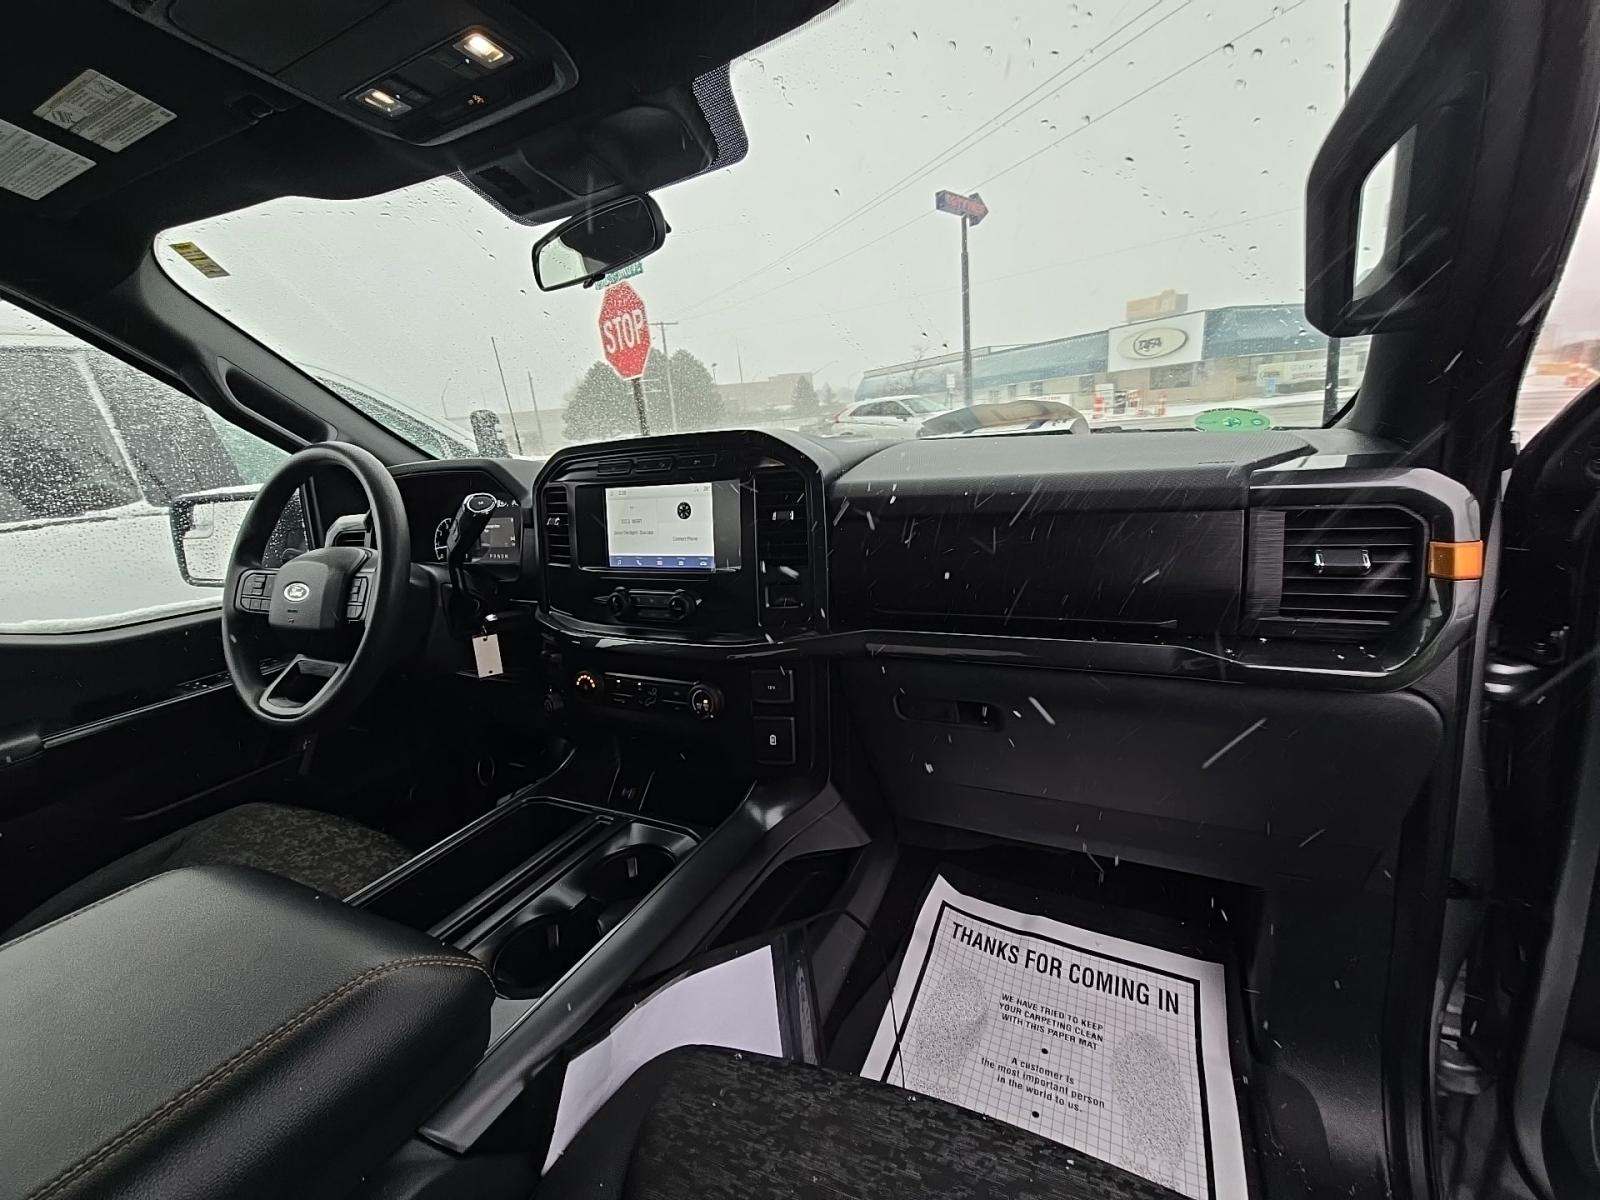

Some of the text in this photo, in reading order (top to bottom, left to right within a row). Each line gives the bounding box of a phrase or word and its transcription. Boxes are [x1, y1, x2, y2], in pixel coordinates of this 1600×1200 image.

[603, 308, 643, 354] STOP
[952, 922, 1179, 1015] THANKS FOR COMING IN
[1000, 1002, 1104, 1042] YOUR CARPETING CLEAN
[1002, 993, 1104, 1031] WE HAVE TRIED TO KEEP
[1002, 1012, 1098, 1050] WITH THIS PAPER MAT
[981, 1057, 1105, 1109] the most important person
[1011, 1057, 1075, 1085] A customer is
[997, 1075, 1082, 1112] in the world to us.
